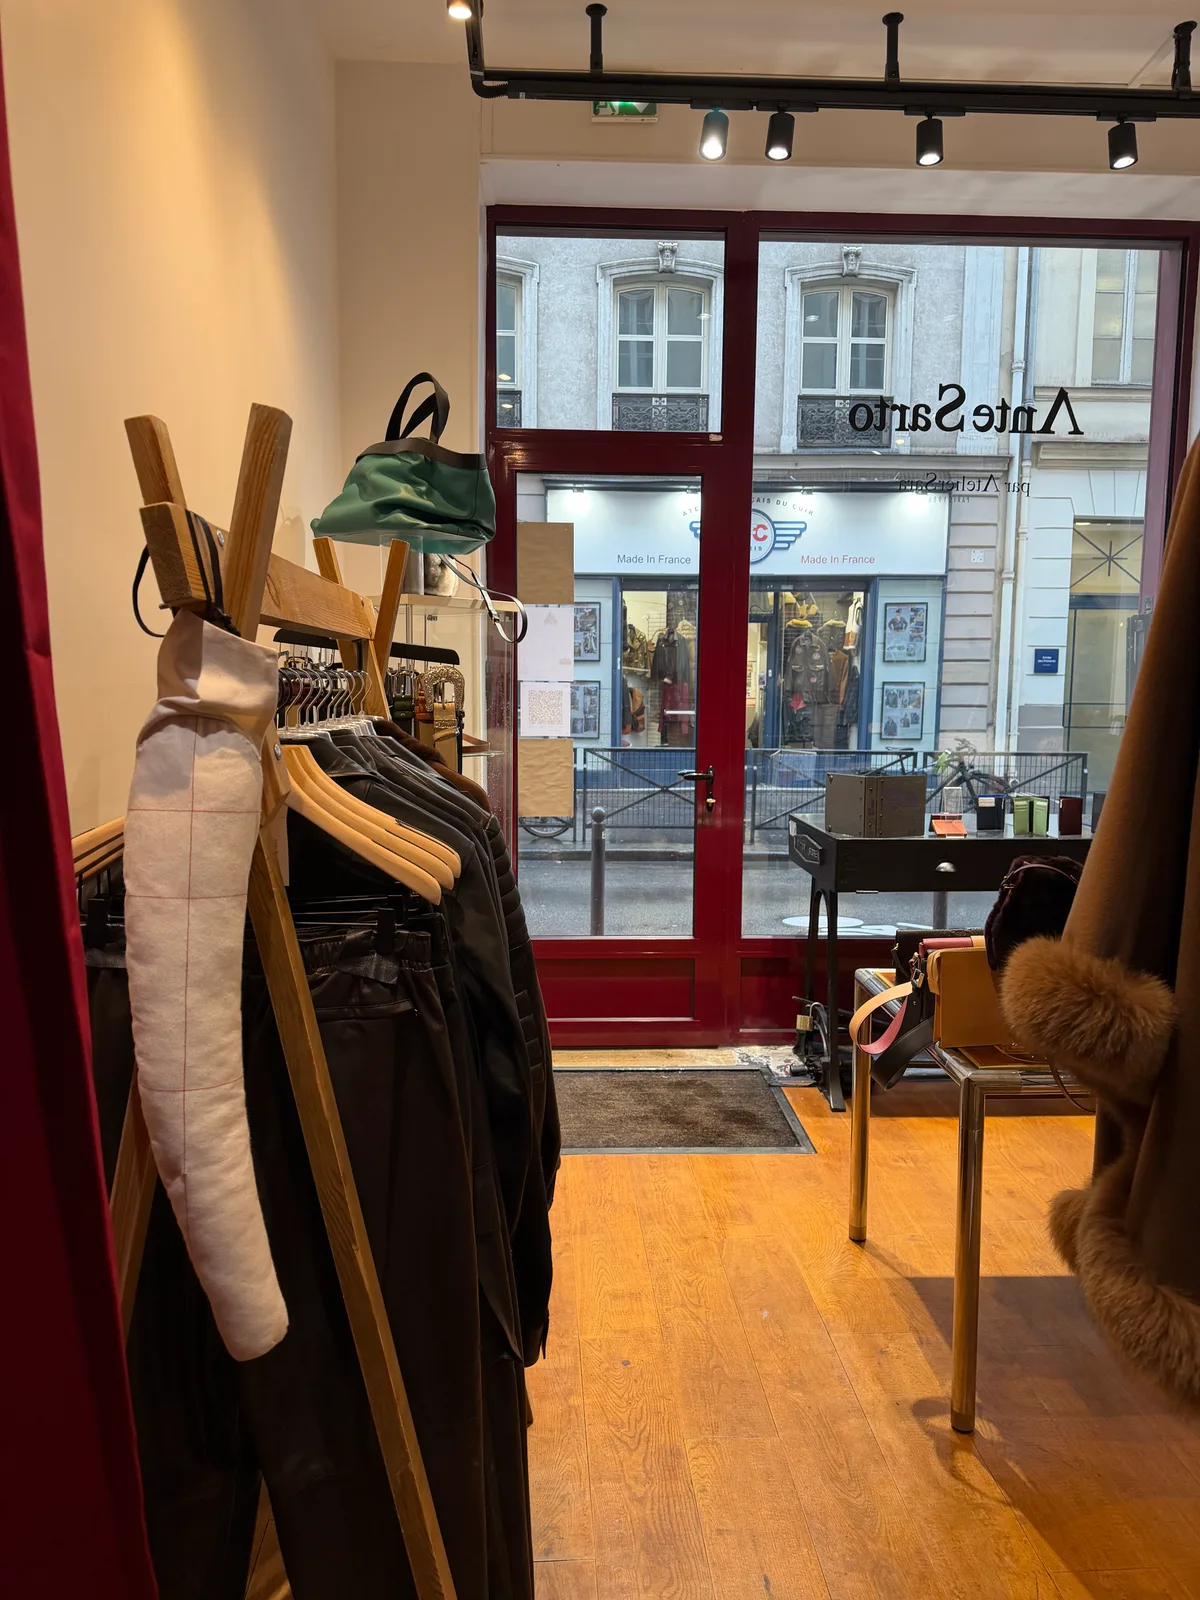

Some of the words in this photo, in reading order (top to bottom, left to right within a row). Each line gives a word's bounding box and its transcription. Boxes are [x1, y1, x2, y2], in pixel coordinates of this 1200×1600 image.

[775, 499, 788, 507] DU
[792, 503, 814, 516] CUIR
[617, 554, 644, 564] Made
[646, 554, 656, 564] In
[658, 554, 692, 565] France
[800, 555, 828, 564] Made
[830, 555, 840, 564] In
[842, 554, 876, 564] France
